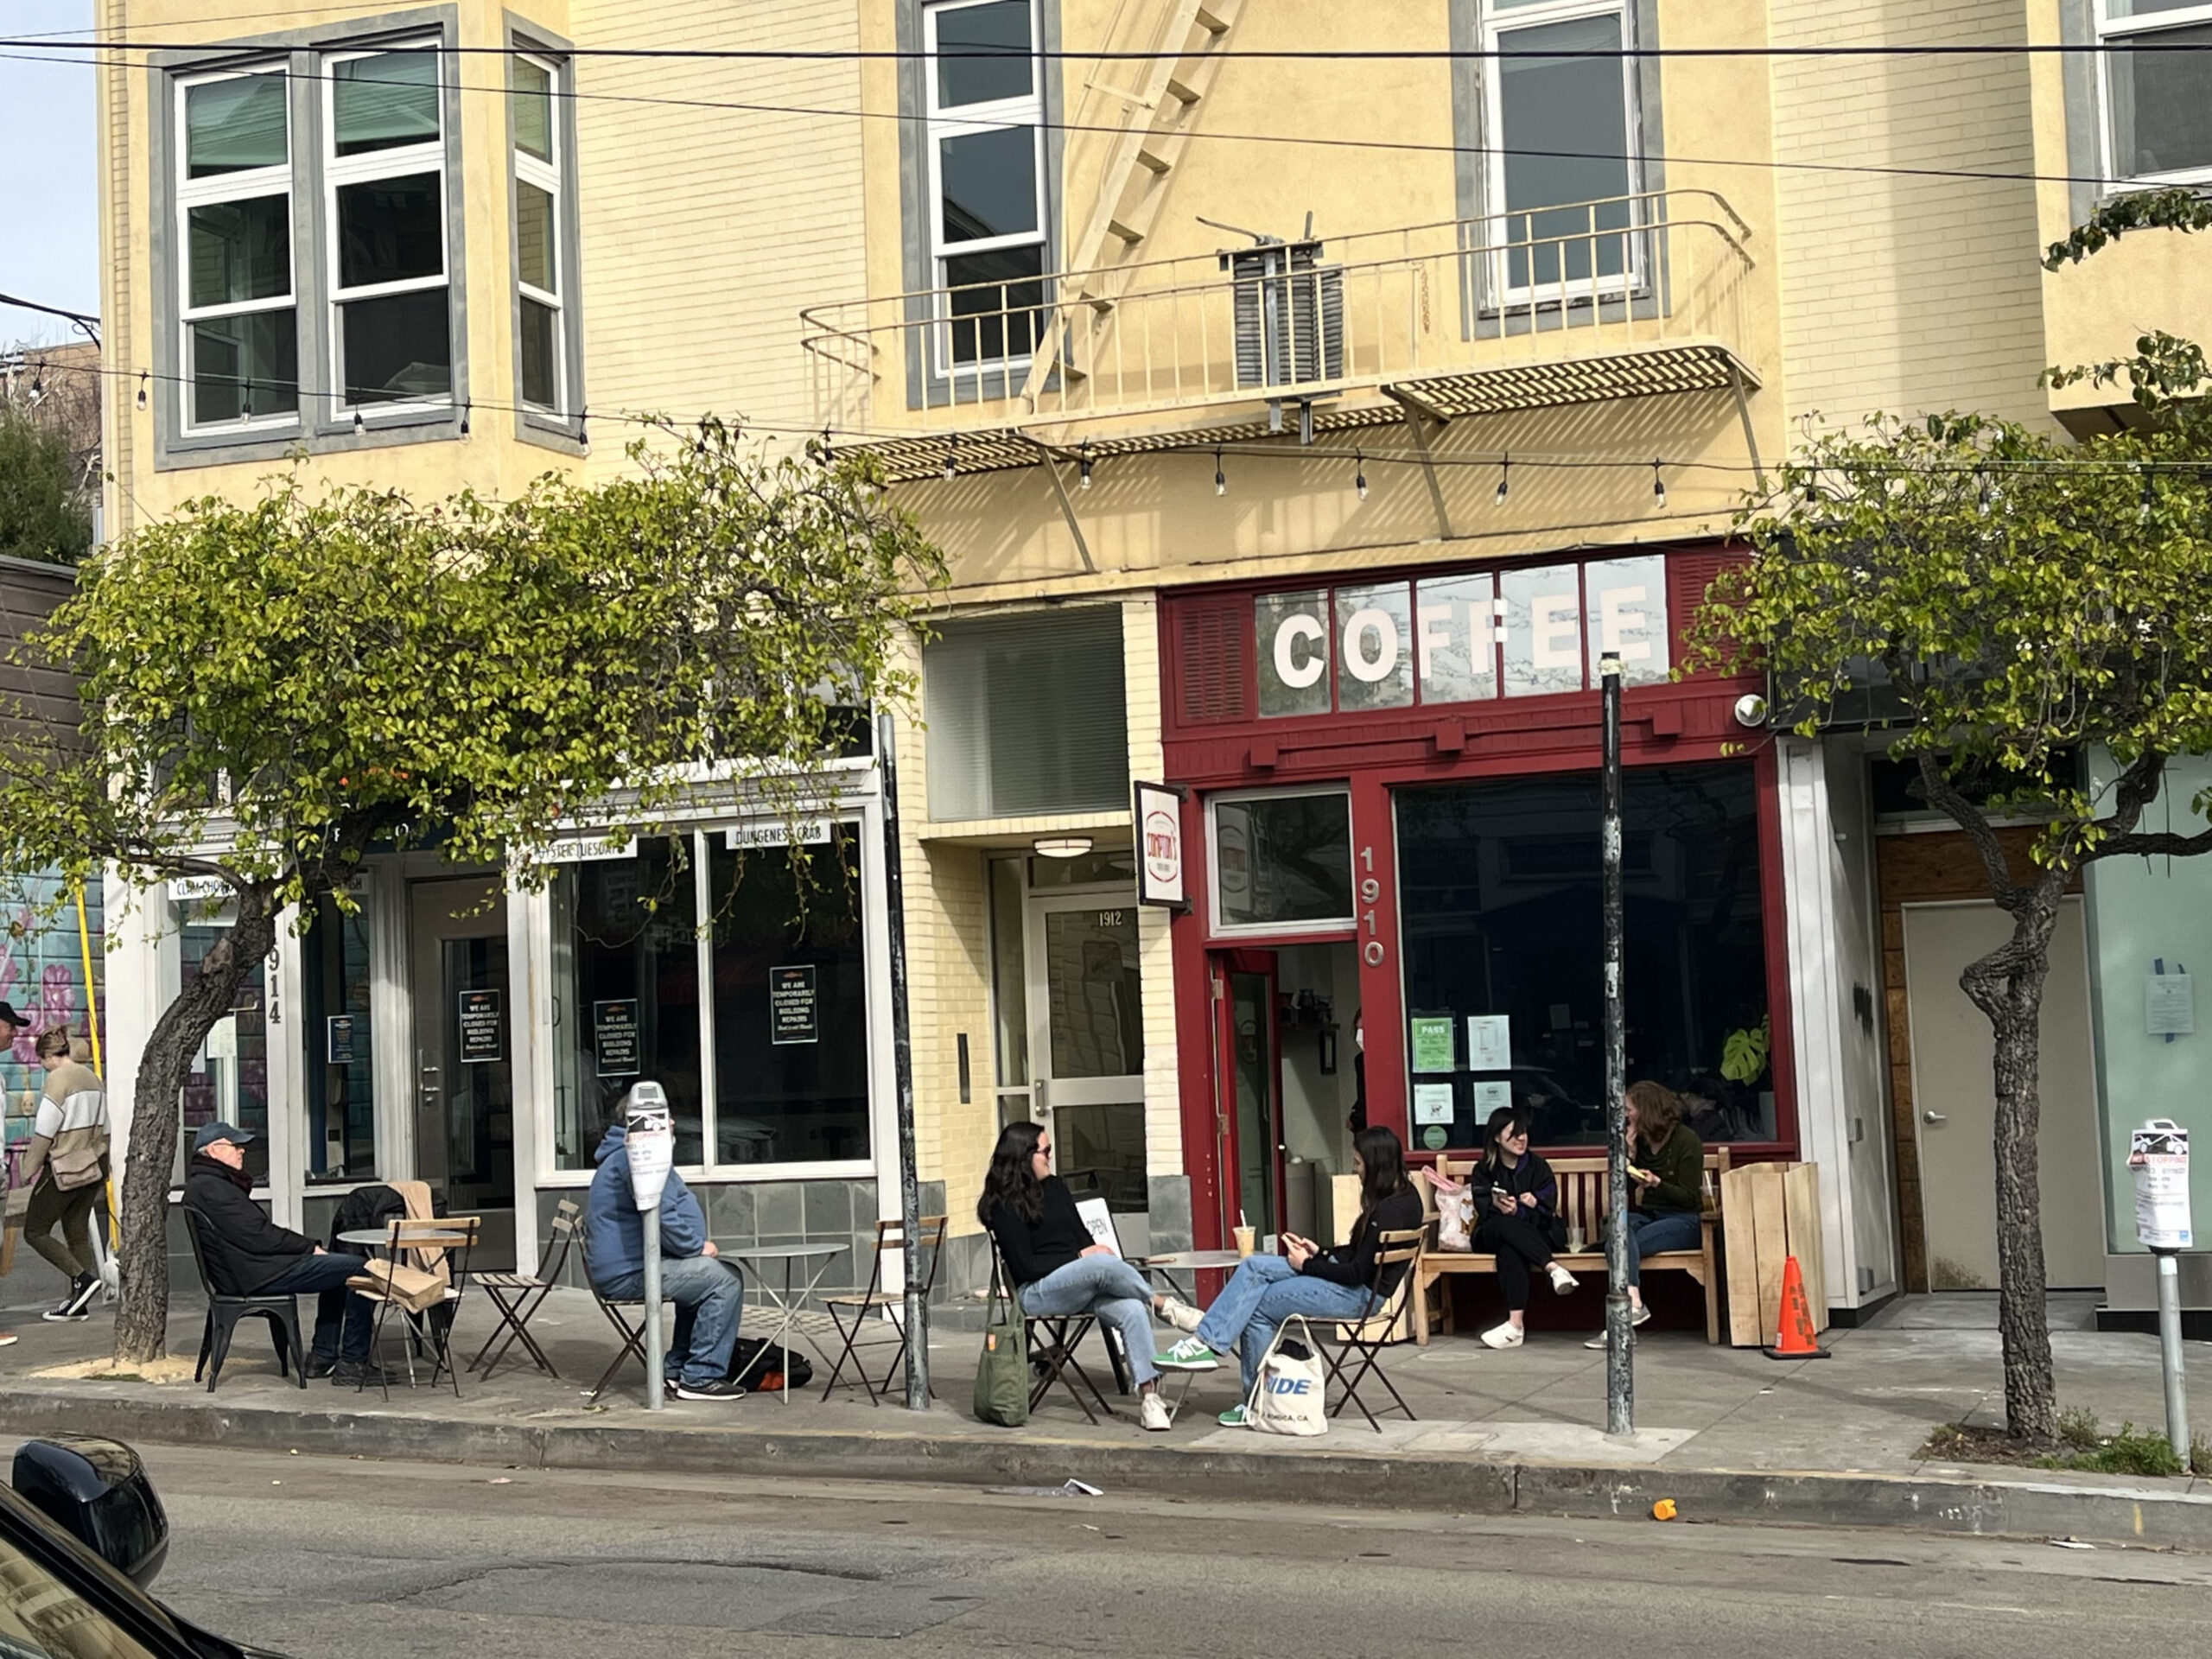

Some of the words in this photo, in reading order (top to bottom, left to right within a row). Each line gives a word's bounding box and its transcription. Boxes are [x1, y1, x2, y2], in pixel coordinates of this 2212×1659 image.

[1274, 586, 1651, 689] COFFEE
[735, 828, 793, 845] DUNGENES
[796, 825, 823, 842] CRAB
[1099, 911, 1122, 927] 1912
[1360, 846, 1384, 967] 1910
[269, 945, 282, 1025] 914
[1421, 1026, 1446, 1035] PASS
